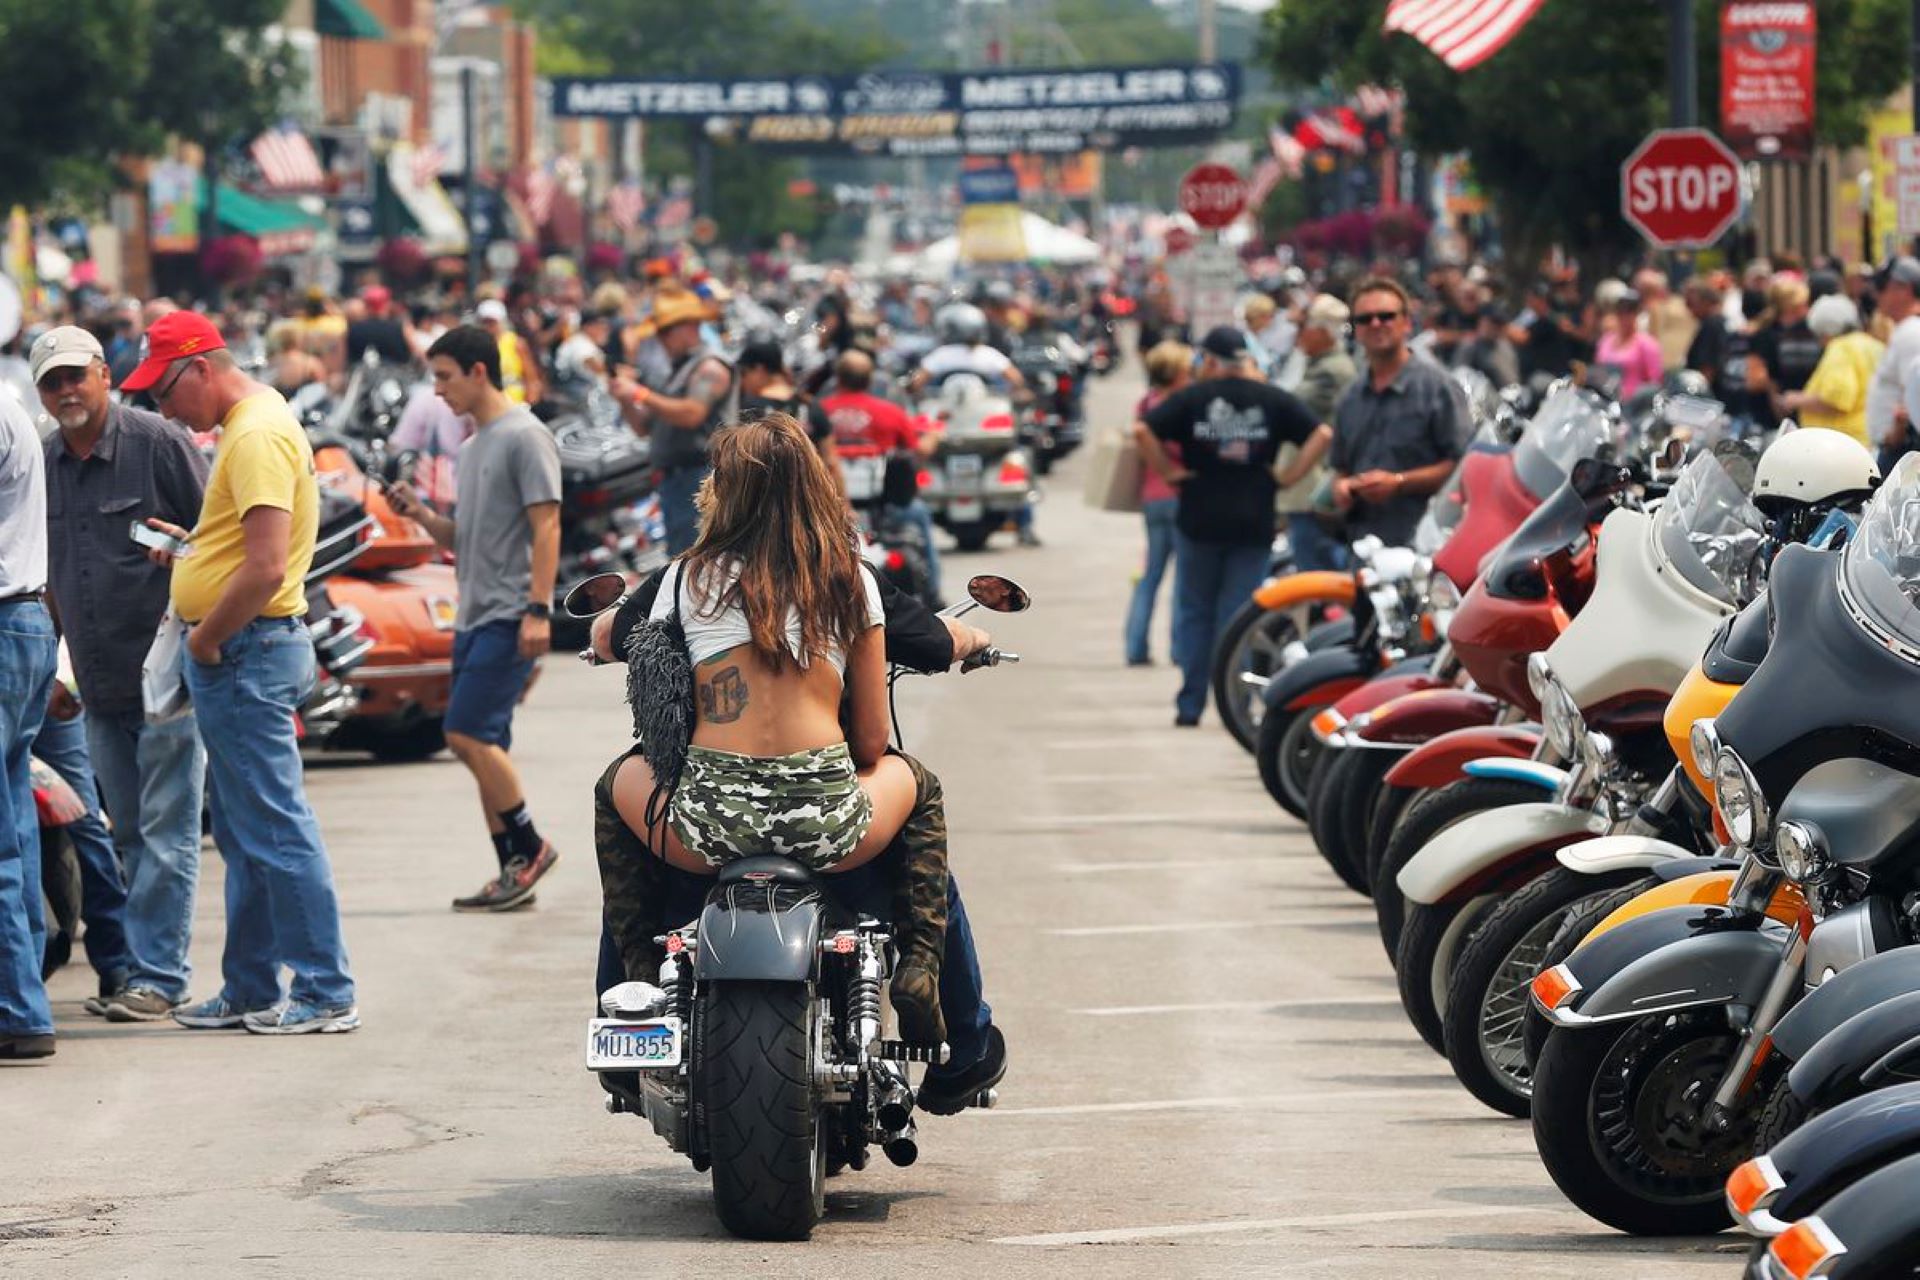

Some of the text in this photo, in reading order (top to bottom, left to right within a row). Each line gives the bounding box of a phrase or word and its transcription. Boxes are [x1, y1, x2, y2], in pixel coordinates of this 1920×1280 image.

[567, 82, 790, 113] METZELER
[961, 69, 1186, 106] METZELER
[1182, 180, 1247, 212] STOP
[1632, 165, 1733, 212] STOP
[596, 1035, 673, 1057] MU1855
